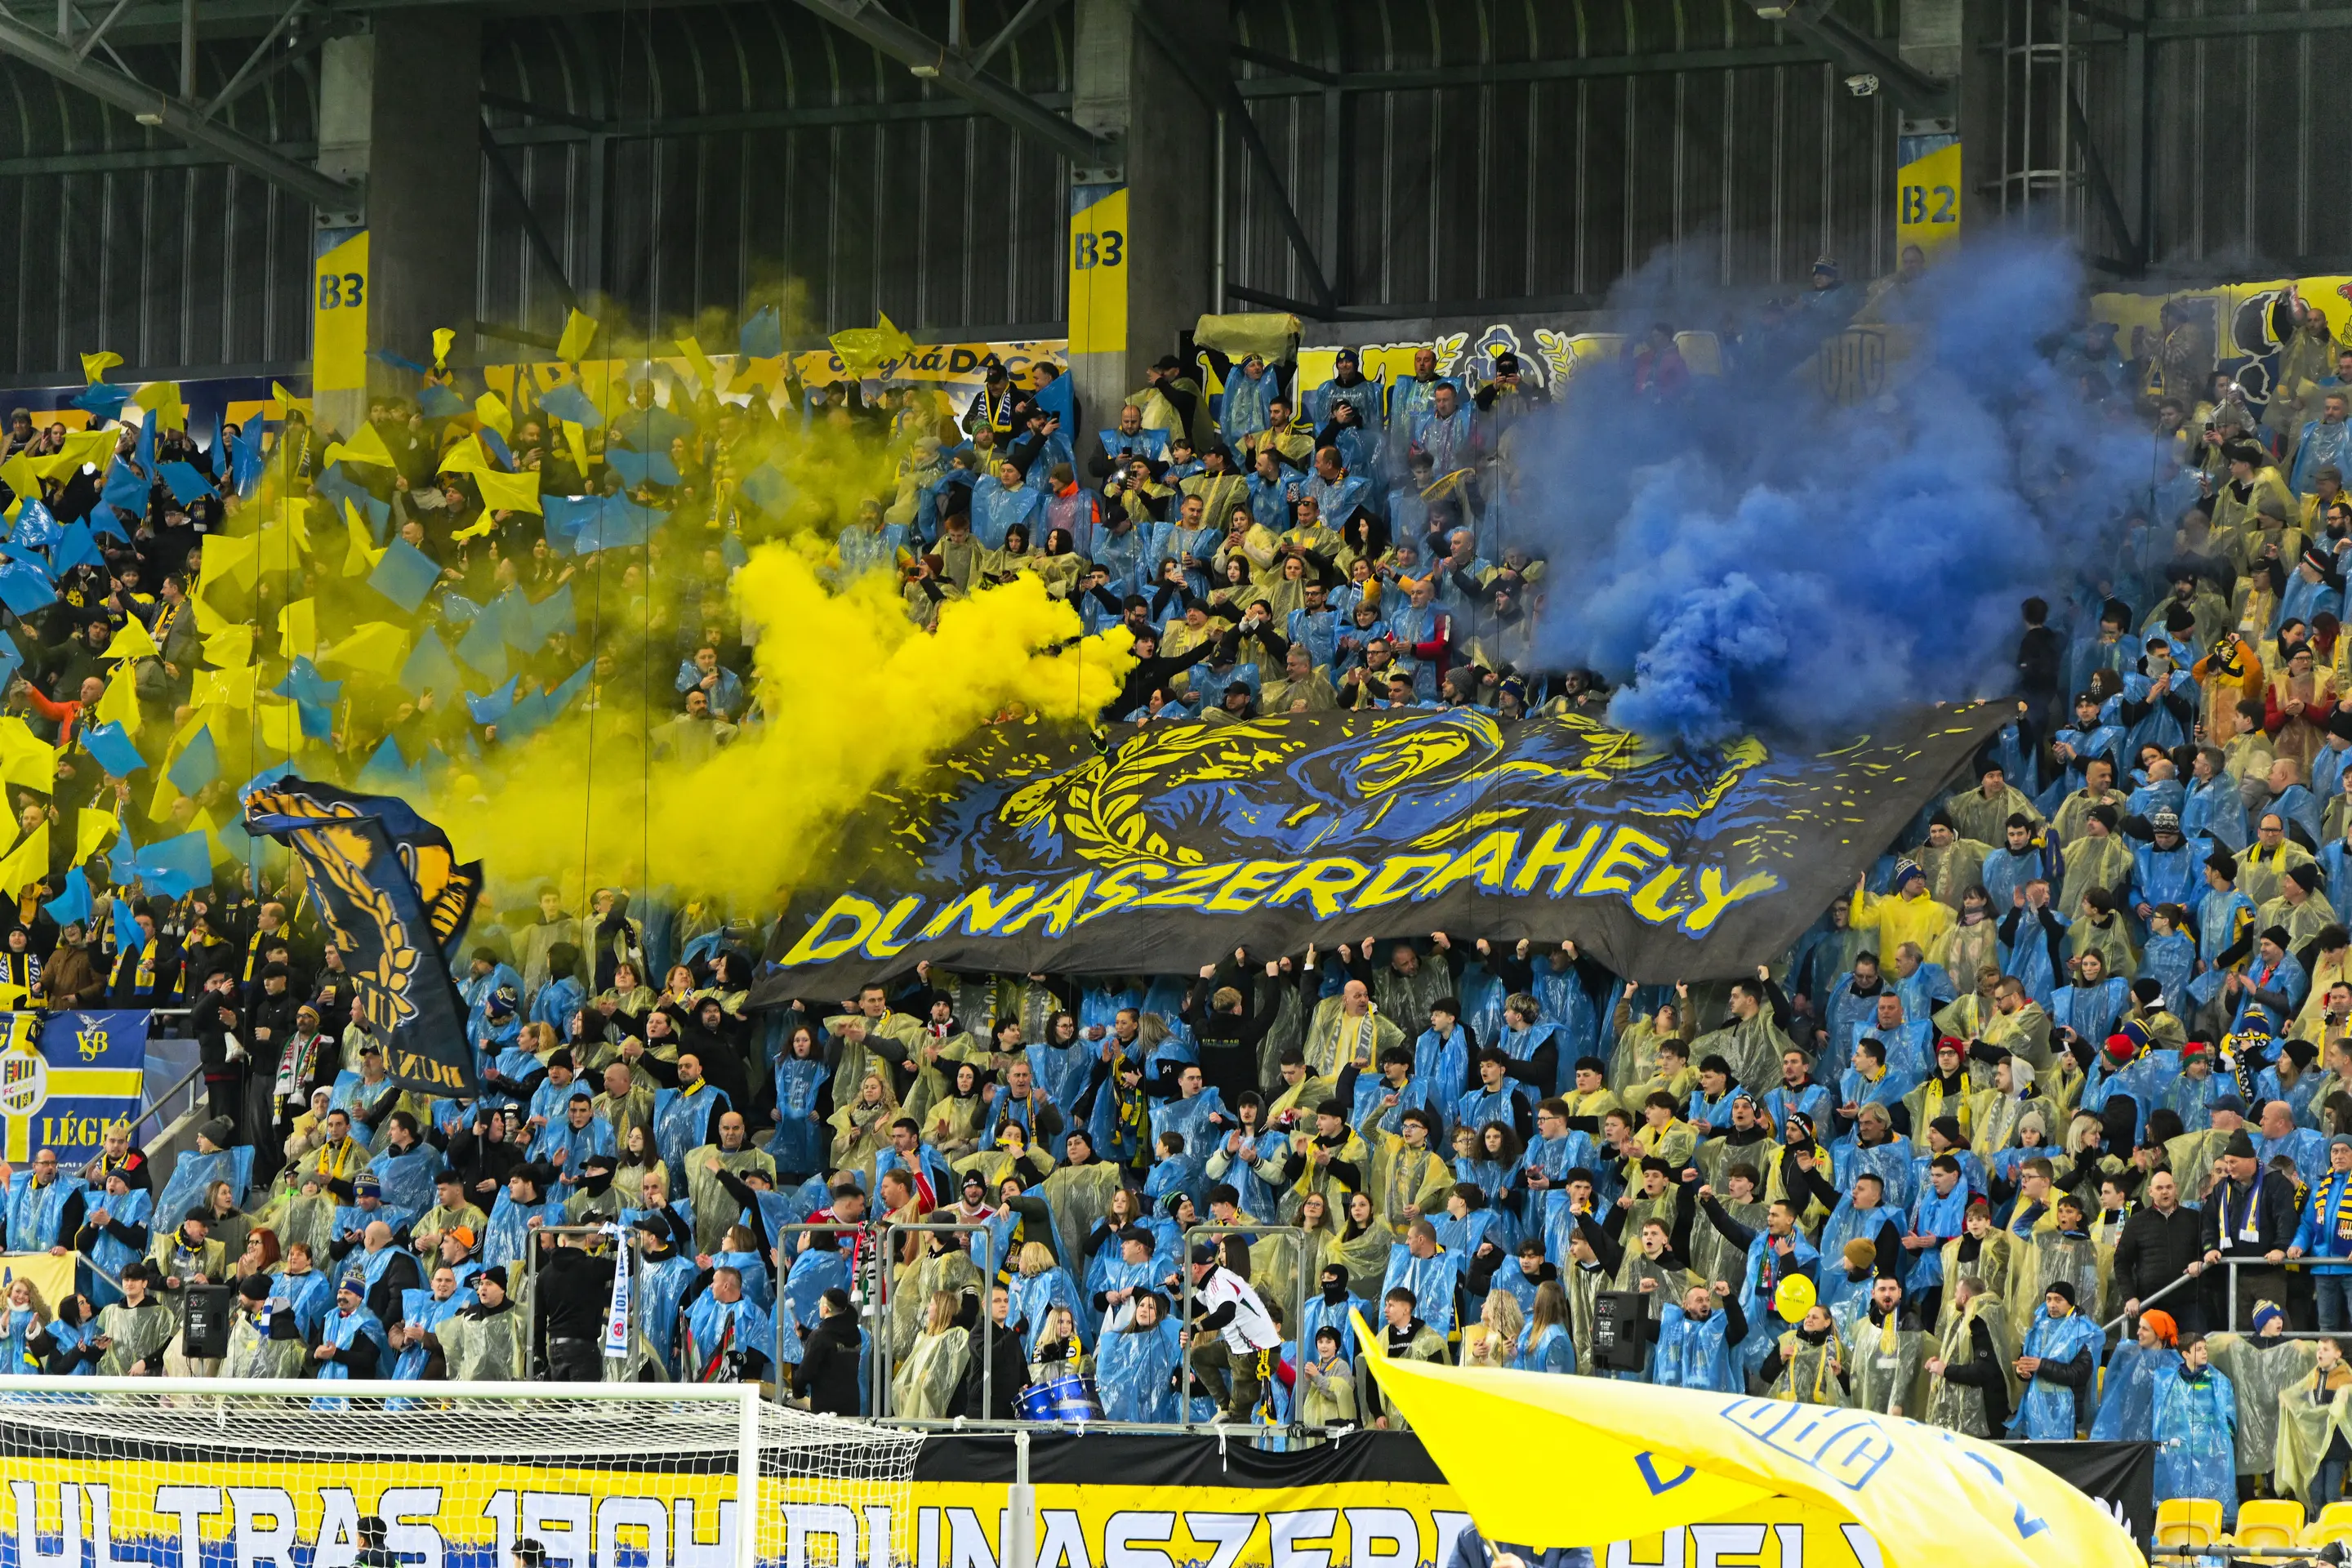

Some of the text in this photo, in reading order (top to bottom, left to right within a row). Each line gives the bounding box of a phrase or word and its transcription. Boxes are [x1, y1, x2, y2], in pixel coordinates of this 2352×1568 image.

[1902, 185, 1956, 225] B2
[1074, 229, 1124, 270] B3
[318, 273, 364, 310] B3
[776, 820, 1786, 969] DUNASZERDAHELY
[8, 1480, 446, 1568] ULTRAS
